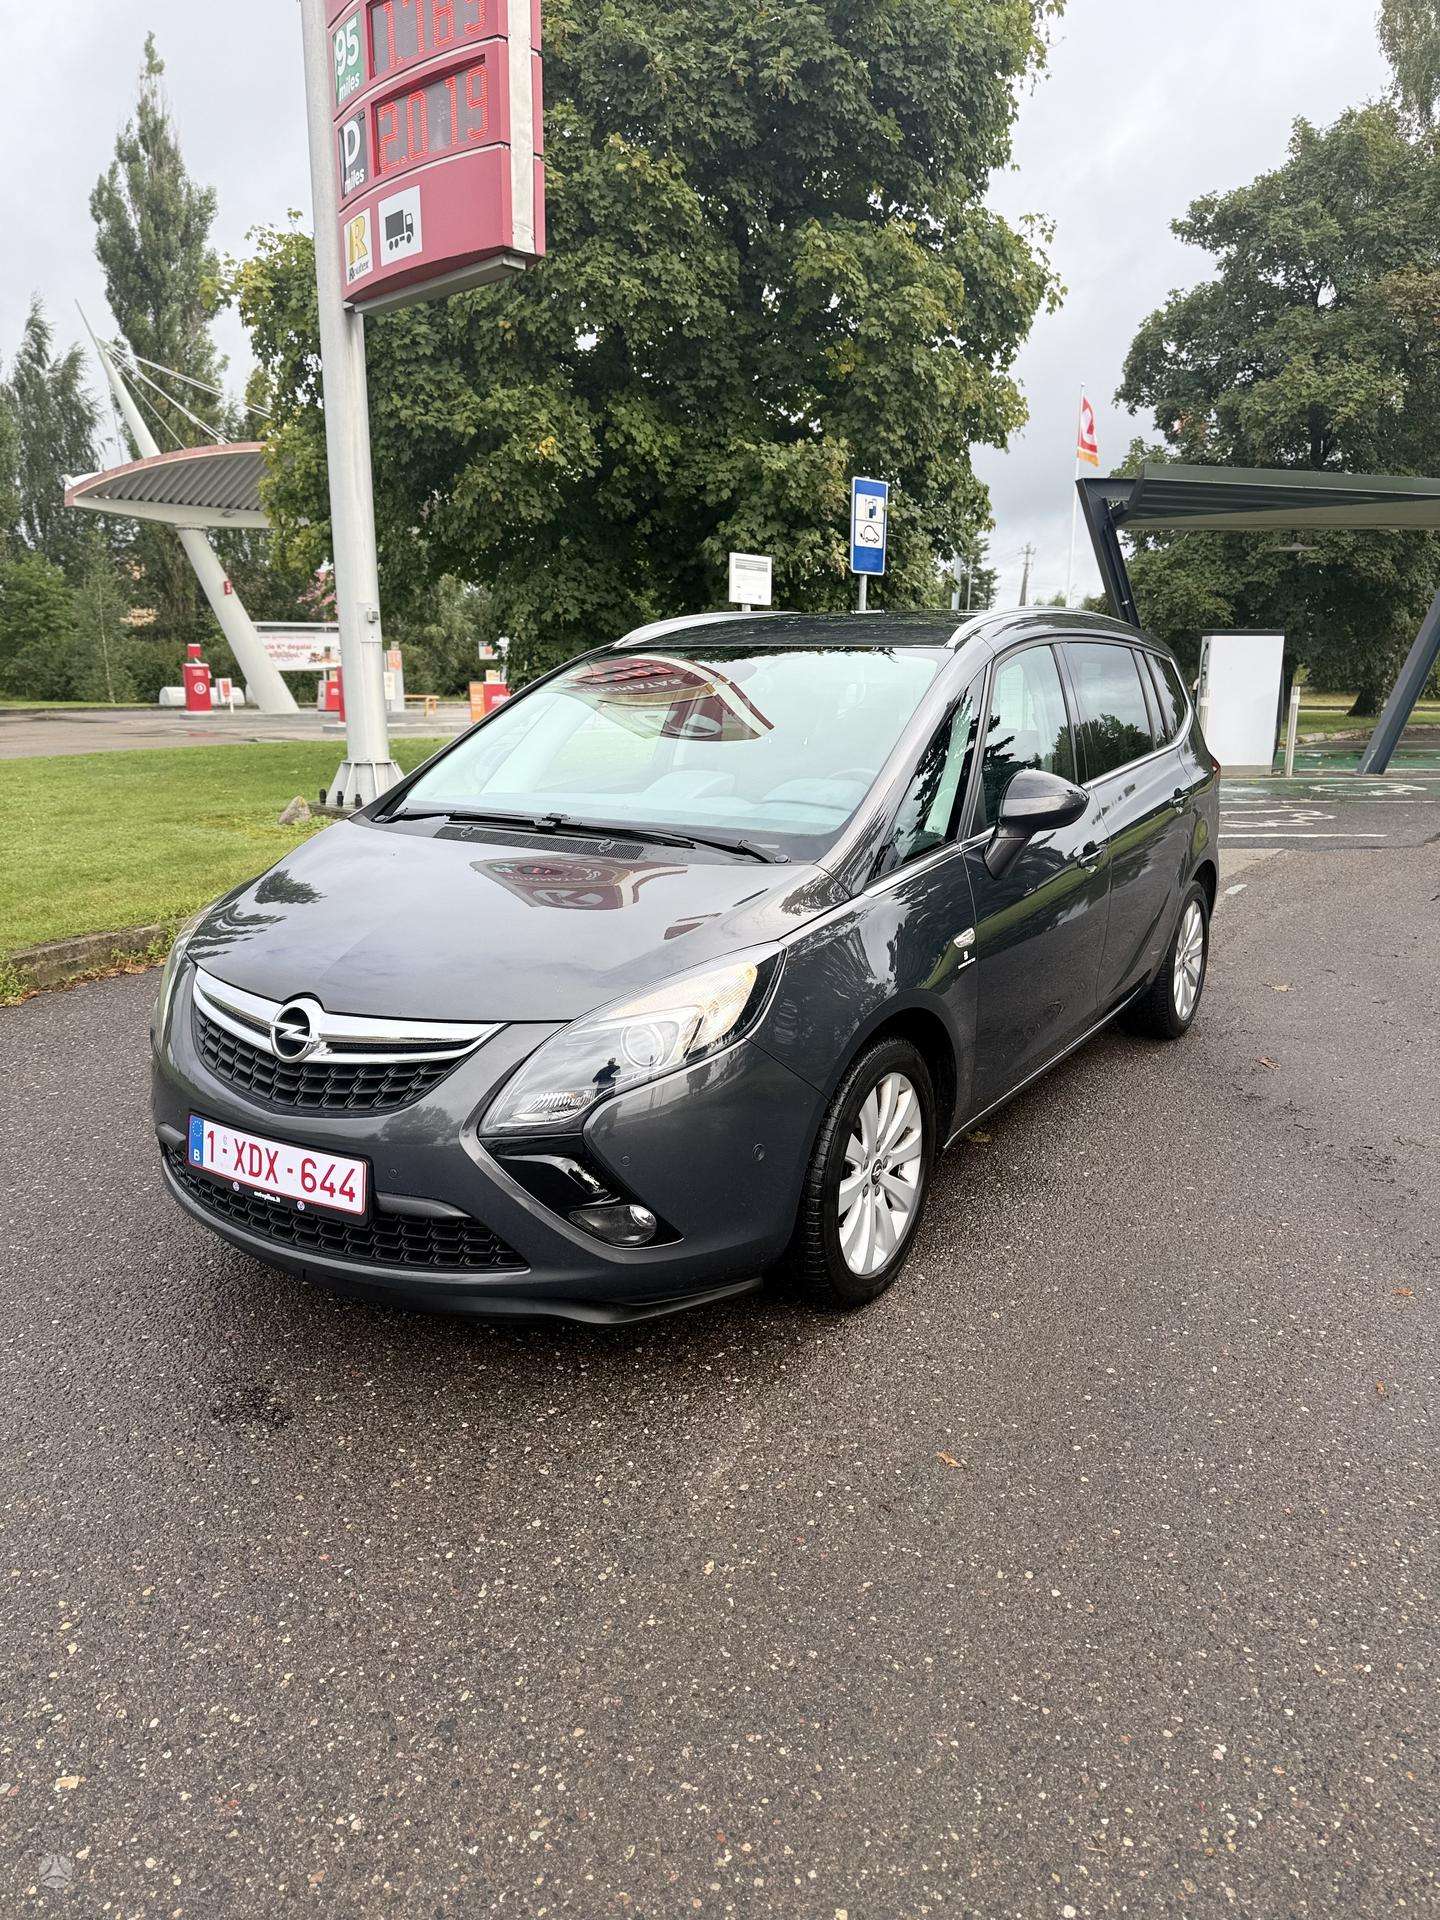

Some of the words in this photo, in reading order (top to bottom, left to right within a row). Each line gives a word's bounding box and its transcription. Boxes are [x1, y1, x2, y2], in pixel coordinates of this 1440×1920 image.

[335, 17, 359, 76] 95
[339, 72, 360, 101] miles
[343, 120, 360, 168] D
[193, 1148, 200, 1161] B
[207, 1130, 356, 1202] 1-XDX-644
